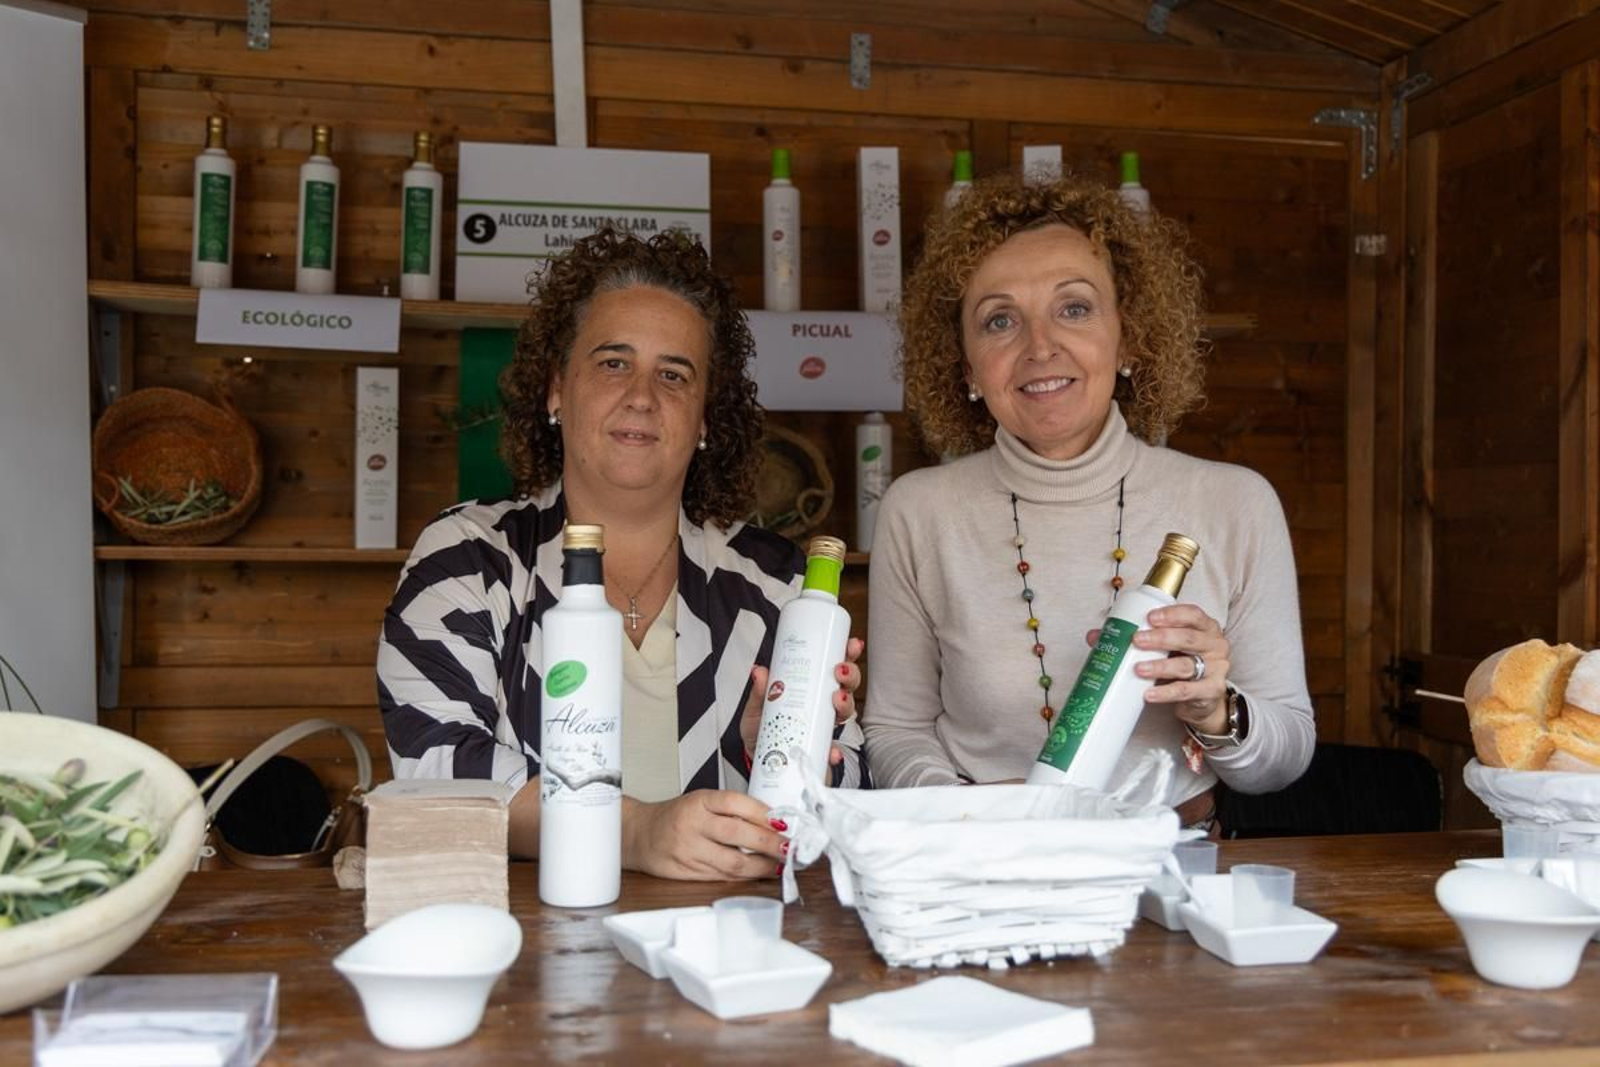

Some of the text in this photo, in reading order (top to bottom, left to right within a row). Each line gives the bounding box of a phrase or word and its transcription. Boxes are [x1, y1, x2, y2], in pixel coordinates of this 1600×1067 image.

[472, 219, 487, 238] 5
[499, 212, 549, 228] ALCUZA
[551, 214, 567, 229] DE
[572, 215, 614, 230] SANTA
[616, 217, 658, 232] CLARA
[241, 309, 353, 330] ECOLÓGICO
[791, 323, 854, 339] PICUAL
[1096, 641, 1120, 656] ceite
[545, 702, 617, 735] Alcuza
